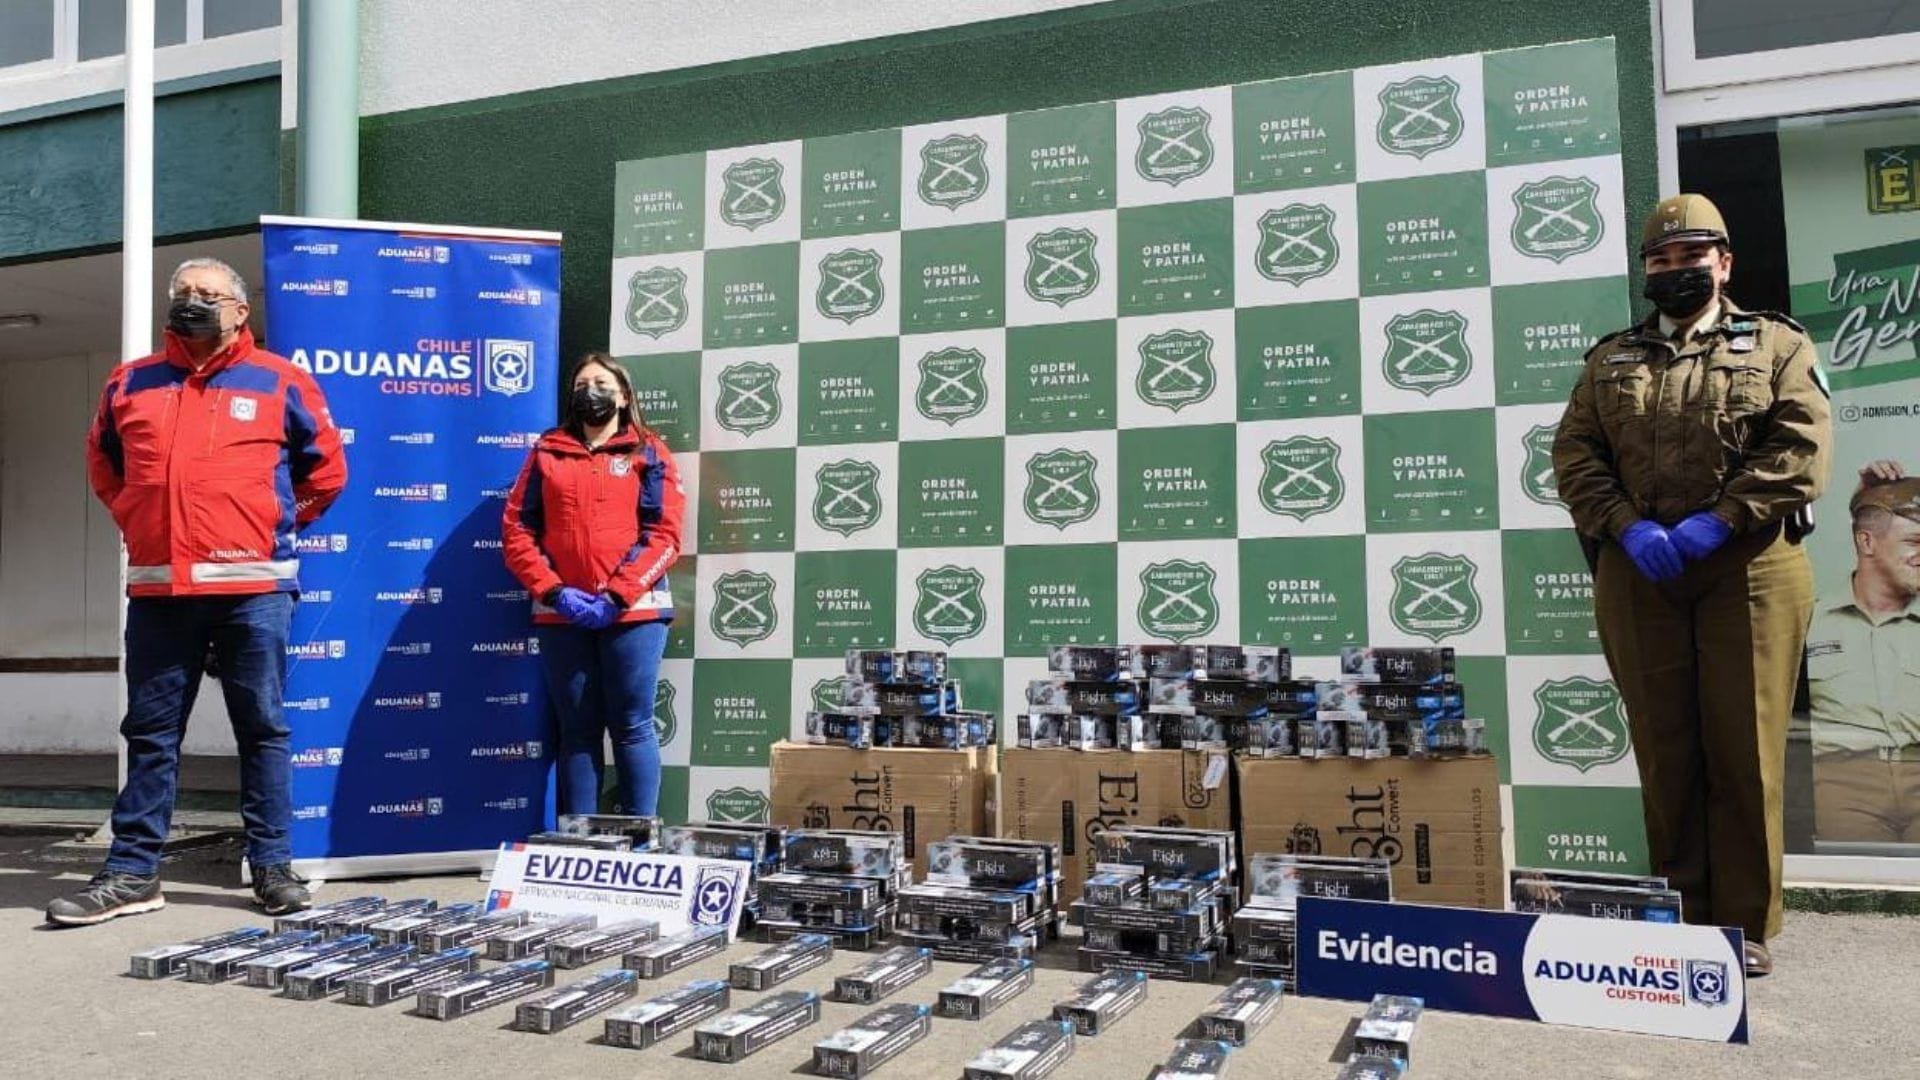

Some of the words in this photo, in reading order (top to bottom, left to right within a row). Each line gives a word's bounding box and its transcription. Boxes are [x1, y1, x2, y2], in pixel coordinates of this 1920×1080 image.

[1514, 85, 1571, 102] ORDEN
[1515, 103, 1524, 115] Y
[1530, 96, 1588, 113] PATRIA
[1260, 116, 1310, 132] ORDEN
[1260, 134, 1269, 145] Y
[1274, 128, 1327, 143] PATRIA
[1030, 144, 1077, 159] ORDEN
[1031, 158, 1040, 170] Y
[1043, 155, 1091, 169] PATRIA
[823, 169, 866, 183] ORDEN
[823, 184, 832, 193] Y
[834, 180, 878, 192] PATRIA
[1386, 216, 1440, 232] ORDEN
[1386, 234, 1396, 245] Y
[1401, 229, 1457, 244] PATRIA
[1142, 242, 1192, 256] ORDEN
[1143, 257, 1152, 268] Y
[1155, 253, 1206, 268] PATRIA
[923, 264, 968, 277] ORDEN
[281, 282, 331, 292] ADUANAS
[723, 282, 765, 294] ORDEN
[923, 277, 932, 289] Y
[935, 274, 981, 287] PATRIA
[1828, 270, 1889, 305] Una
[723, 295, 732, 306] Y
[735, 292, 776, 305] PATRIA
[1879, 264, 1920, 320] N
[1524, 322, 1581, 338] ORDEN
[416, 338, 473, 353] CHILE
[1263, 343, 1315, 358] ORDEN
[1524, 339, 1534, 352] Y
[1540, 335, 1600, 350] PATRIA
[290, 349, 473, 379] ADUANAS
[1029, 361, 1077, 375] ORDEN
[1263, 358, 1274, 371] Y
[1278, 355, 1331, 370] PATRIA
[820, 377, 862, 389] ORDEN
[1029, 376, 1039, 388] Y
[1042, 373, 1091, 386] PATRIA
[380, 380, 473, 396] CUSTOMS
[637, 389, 668, 400] RDEN
[820, 390, 829, 400] Y
[831, 387, 875, 399] PATRIA
[1393, 454, 1448, 467] ORDEN
[1143, 467, 1193, 480] ORDEN
[1393, 470, 1403, 480] Y
[1408, 467, 1465, 481] PATRIA
[921, 478, 966, 490] ORDEN
[1144, 480, 1152, 491] Y
[1157, 477, 1208, 491] PATRIA
[374, 487, 429, 498] ADUANAS
[720, 487, 761, 498] ORDEN
[921, 491, 930, 501] Y
[933, 487, 979, 501] PATRIA
[720, 499, 728, 509] Y
[730, 496, 773, 508] PATRIA
[1267, 579, 1321, 590] ORDEN
[1535, 572, 1594, 586] ORDEN
[816, 588, 860, 600] ORDEN
[1029, 584, 1077, 596] ORDEN
[1535, 587, 1545, 599] Y
[1556, 586, 1595, 599] PATR
[1029, 597, 1038, 608] Y
[1041, 596, 1091, 608] PATRIA
[1267, 593, 1277, 604] Y
[1282, 592, 1337, 604] PATRIA
[816, 601, 825, 611] Y
[827, 600, 872, 611] PATRIA
[471, 642, 525, 652] ADUANAS
[374, 697, 425, 707] ADUANAS
[714, 697, 755, 708] ORDEN
[1204, 690, 1234, 704] Eight
[1267, 690, 1288, 704] ight
[1375, 695, 1408, 710] Eight
[714, 709, 722, 720] Y
[724, 709, 768, 720] PATRIA
[290, 753, 323, 764] ANAS
[368, 803, 425, 814] ADUANAS
[1387, 778, 1400, 834] Convert
[1547, 833, 1608, 848] ORDEN
[1152, 849, 1185, 865] Eight
[1548, 849, 1558, 861] Y
[1565, 850, 1628, 863] PATRIA
[524, 854, 683, 890] EVIDENCIA
[976, 860, 1005, 876] Eight
[1314, 881, 1351, 897] Eight
[1590, 903, 1634, 920] Eight
[1318, 930, 1498, 976] Evidencia
[1633, 955, 1680, 970] CHILE
[1534, 959, 1680, 991] ADUANAS
[1605, 987, 1681, 1006] CUSTOMS
